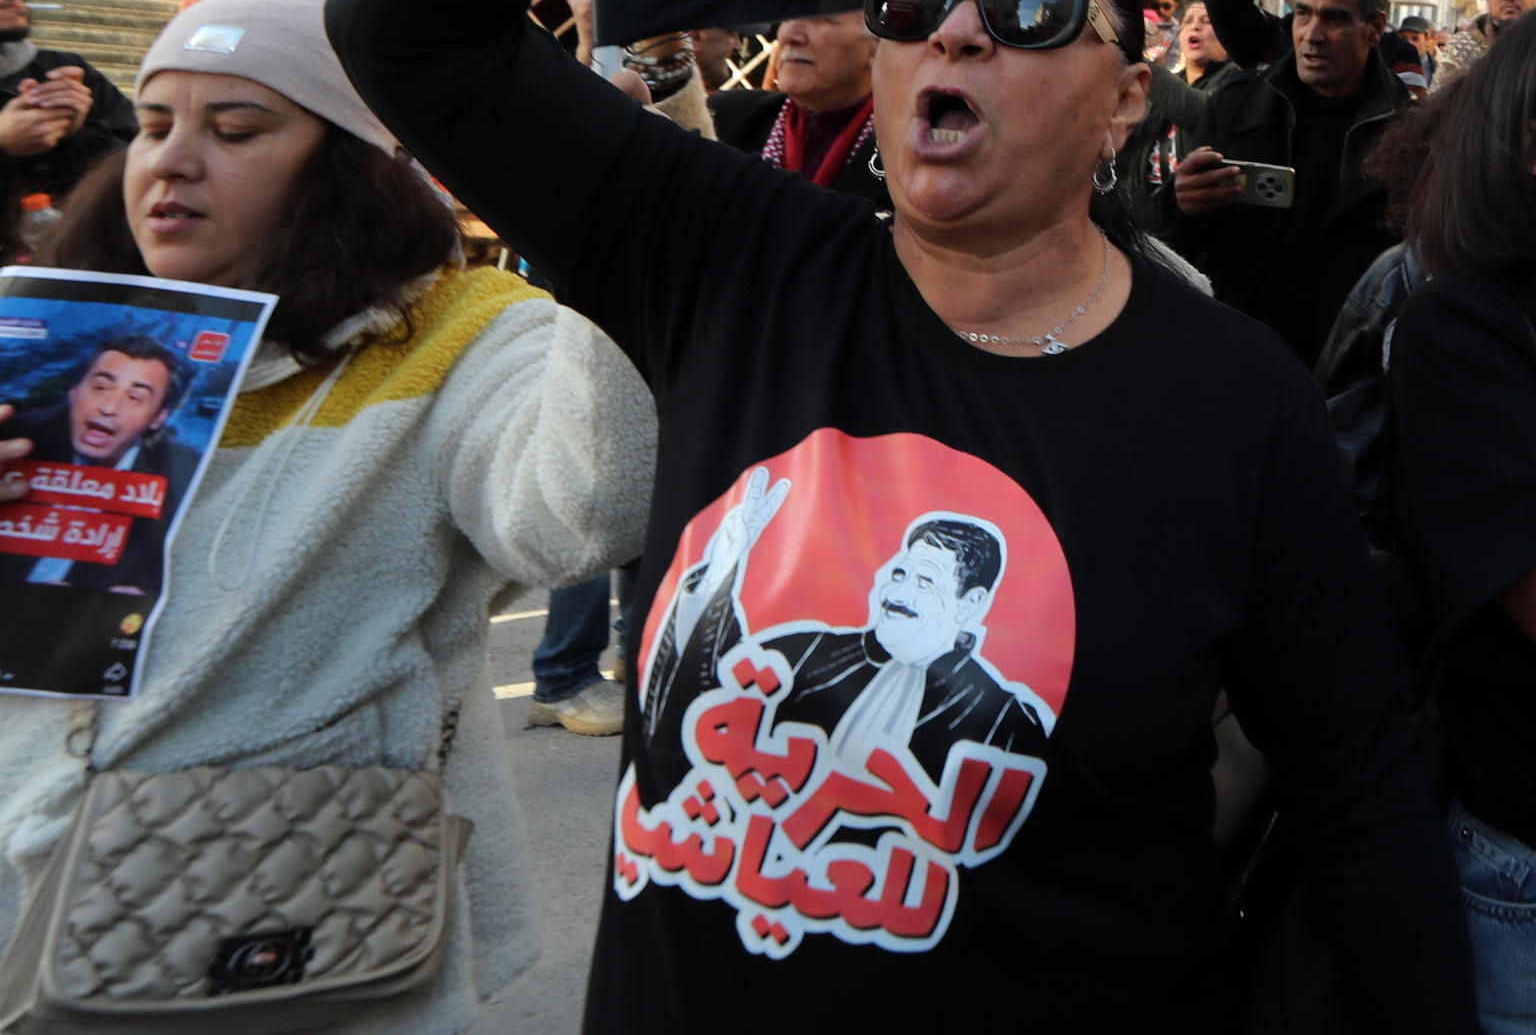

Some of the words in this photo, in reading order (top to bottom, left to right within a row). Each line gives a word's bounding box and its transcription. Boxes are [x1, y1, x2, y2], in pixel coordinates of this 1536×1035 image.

[30, 467, 116, 499] معلقة
[695, 656, 1036, 854] الحرية
[614, 777, 950, 947] للعياشي
